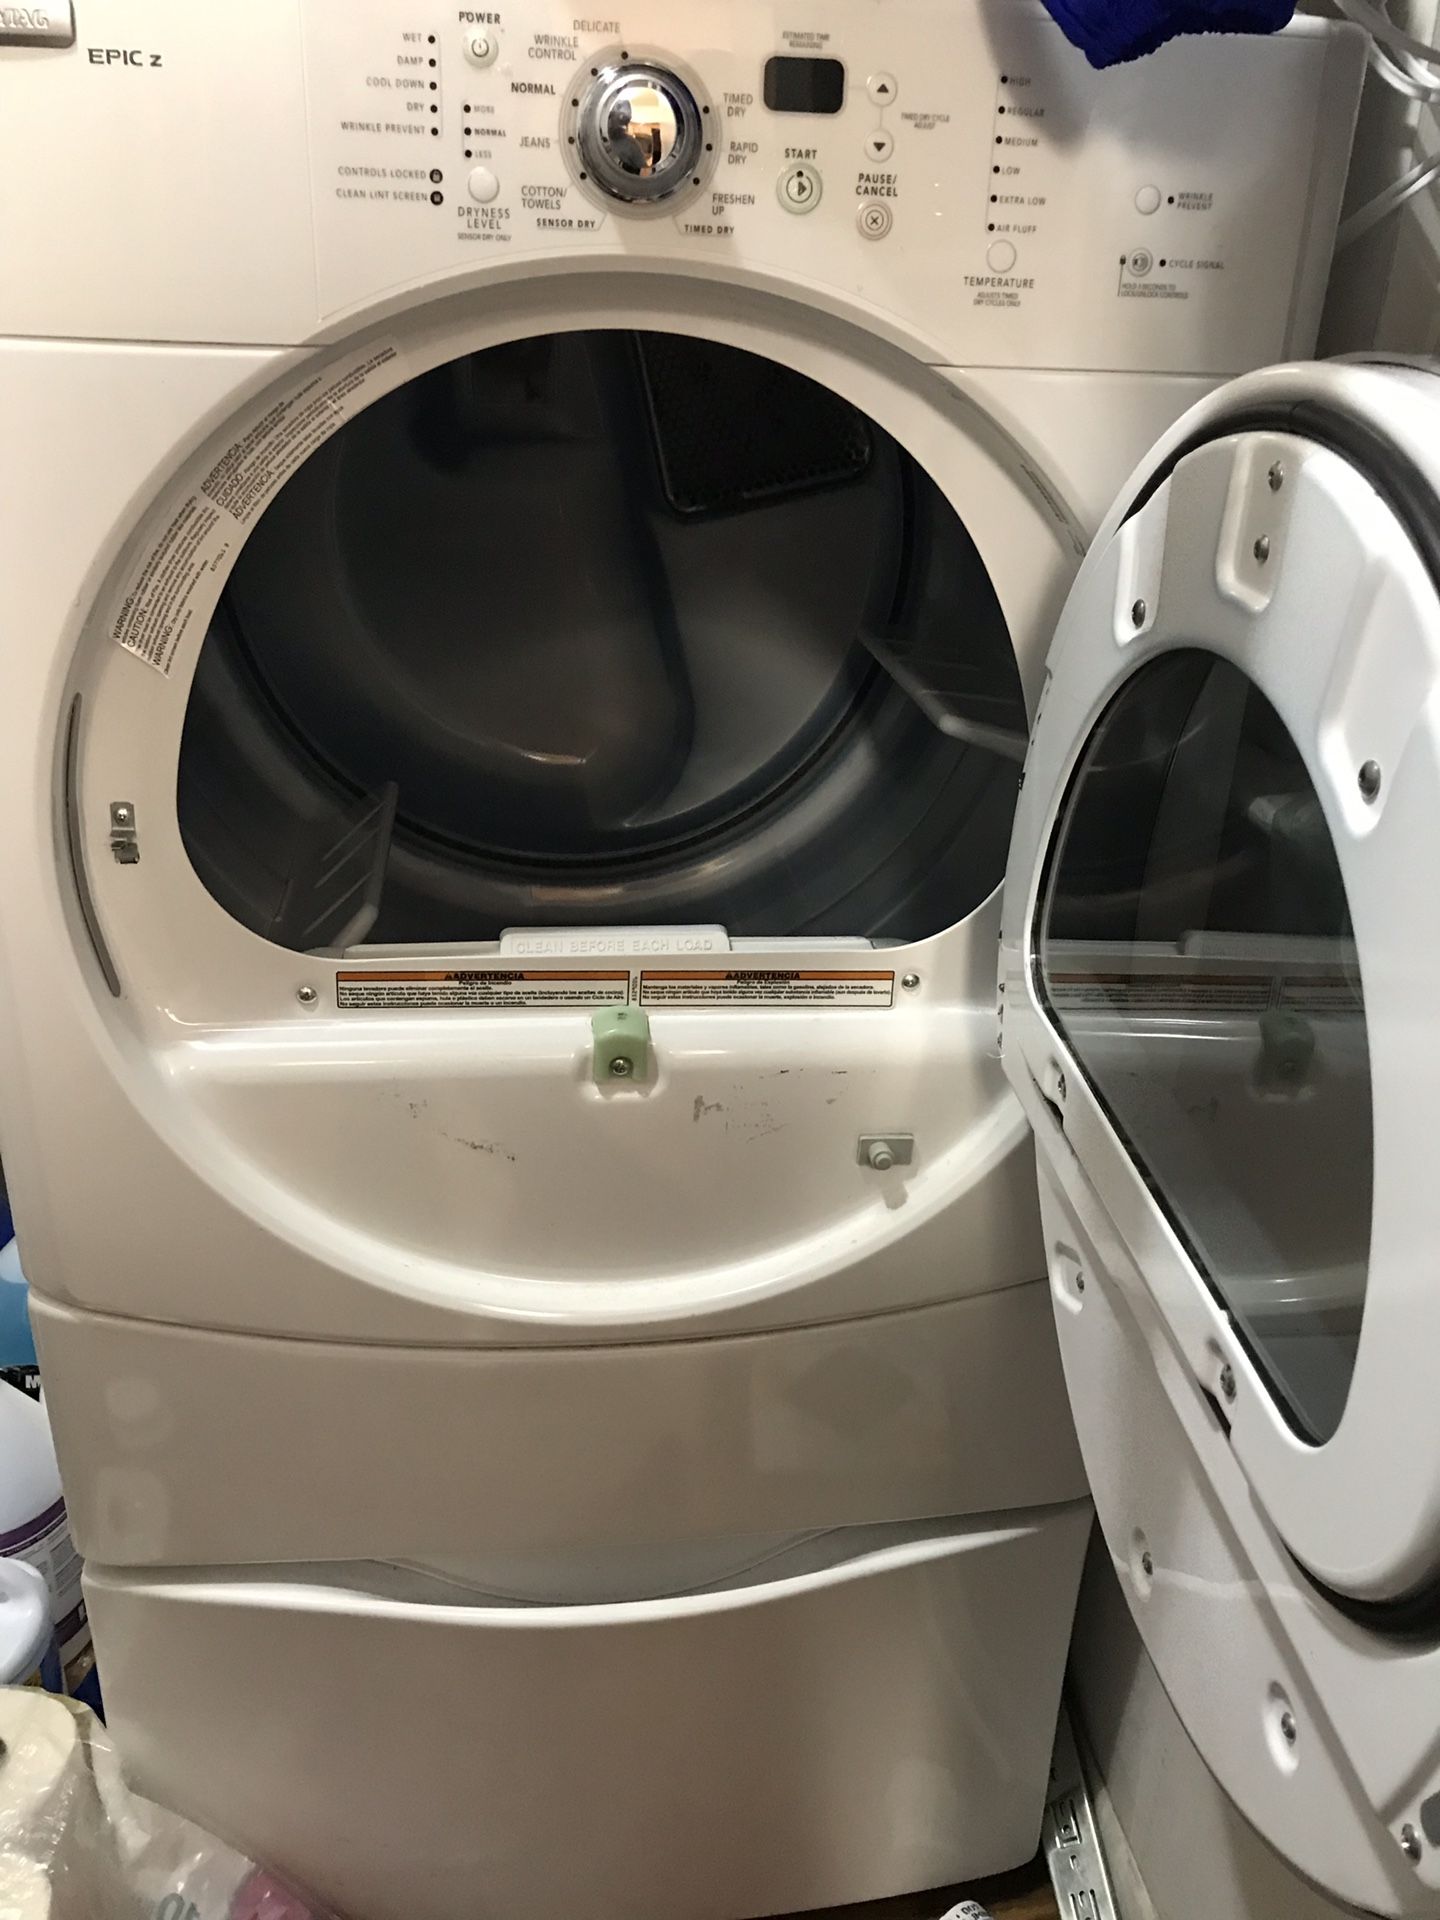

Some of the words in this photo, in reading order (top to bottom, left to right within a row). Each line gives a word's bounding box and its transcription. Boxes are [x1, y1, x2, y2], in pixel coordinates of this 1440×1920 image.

[459, 11, 501, 24] POWER
[573, 20, 620, 33] DELICATE
[402, 33, 423, 42] WET
[534, 34, 579, 48] WRINKLE
[87, 48, 143, 67] EPIC
[528, 47, 577, 61] CONTROL
[397, 56, 424, 65] DAMP
[366, 76, 392, 88] COOL
[395, 78, 425, 89] DOWN
[511, 82, 556, 95] NORMAL
[723, 92, 753, 105] TIMED
[406, 102, 425, 112] DRY
[727, 106, 746, 117] DRY
[1007, 107, 1045, 117] REGULAR
[340, 121, 381, 132] WRINKLE
[385, 123, 425, 134] PREVENT
[474, 128, 507, 137] NORMAL
[520, 136, 551, 148] JEANS
[730, 141, 758, 153] RAPID
[1004, 137, 1038, 147] MEDIUM
[728, 154, 747, 165] DRY
[785, 148, 818, 160] START
[338, 166, 387, 178] CONTROLS
[390, 170, 427, 180] LOCKED
[1002, 166, 1020, 175] LOW
[858, 173, 897, 185] PAUSE/
[336, 188, 366, 199] CLEAN
[369, 190, 389, 200] LINT
[393, 191, 428, 201] SCREEN
[521, 185, 567, 198] COTTON/
[855, 185, 899, 197] CANCEL
[522, 199, 561, 210] TOWELS
[712, 193, 755, 205] FRESHEN
[1000, 196, 1025, 205] EXTRA
[1028, 197, 1047, 206] LOW
[457, 206, 511, 219] DRYNESS
[712, 206, 724, 216] UP
[467, 219, 501, 230] LEVEL
[536, 218, 574, 228] SENSOR
[577, 220, 596, 229] DRY
[684, 224, 713, 234] TIMED
[717, 226, 735, 235] DRY
[996, 224, 1010, 232] AIR
[1013, 225, 1037, 234] FLUFF
[482, 233, 494, 241] DRY
[1169, 260, 1193, 269] CYCLE
[963, 276, 1035, 289] TEMPERATURE
[517, 939, 564, 954] CLEAN
[570, 939, 625, 952] BEFORE
[632, 938, 669, 951] EACH
[676, 938, 713, 951] LOAD
[453, 973, 525, 981] ADVERTENCIA
[733, 972, 801, 980] ADVERTENCIA
